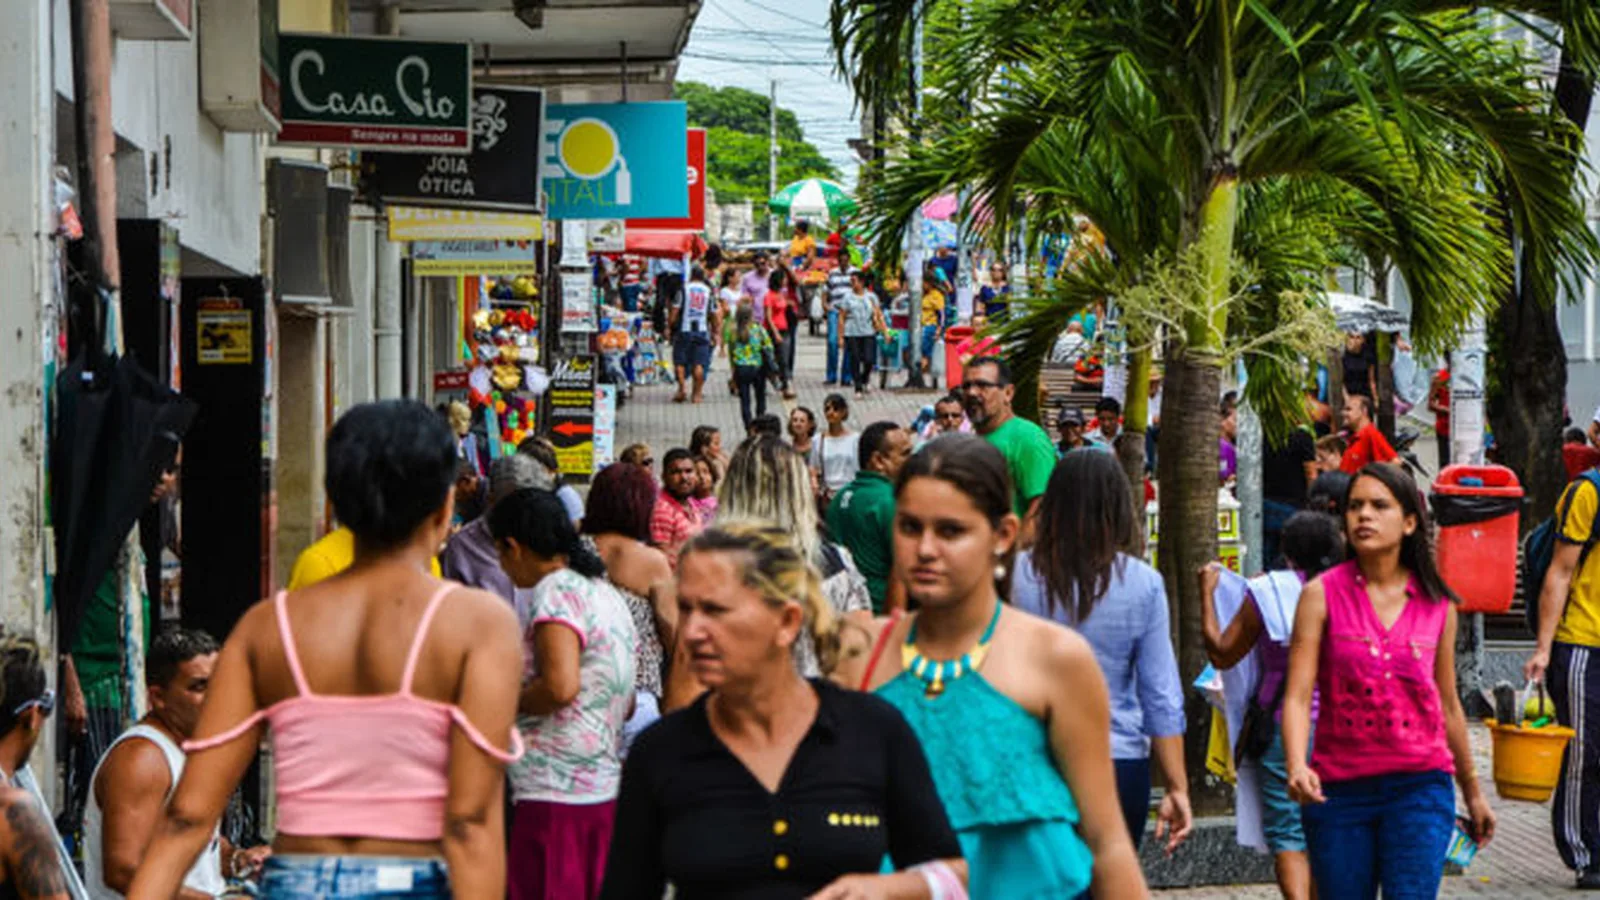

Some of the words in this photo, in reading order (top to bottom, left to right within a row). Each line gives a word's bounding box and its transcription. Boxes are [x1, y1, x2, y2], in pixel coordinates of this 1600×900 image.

[290, 50, 395, 116] Casa
[396, 56, 456, 119] Pio
[351, 128, 399, 142] Sempre
[401, 132, 418, 141] na
[420, 132, 455, 143] moda
[426, 153, 469, 174] JÓIA
[418, 174, 476, 196] ÓTICA
